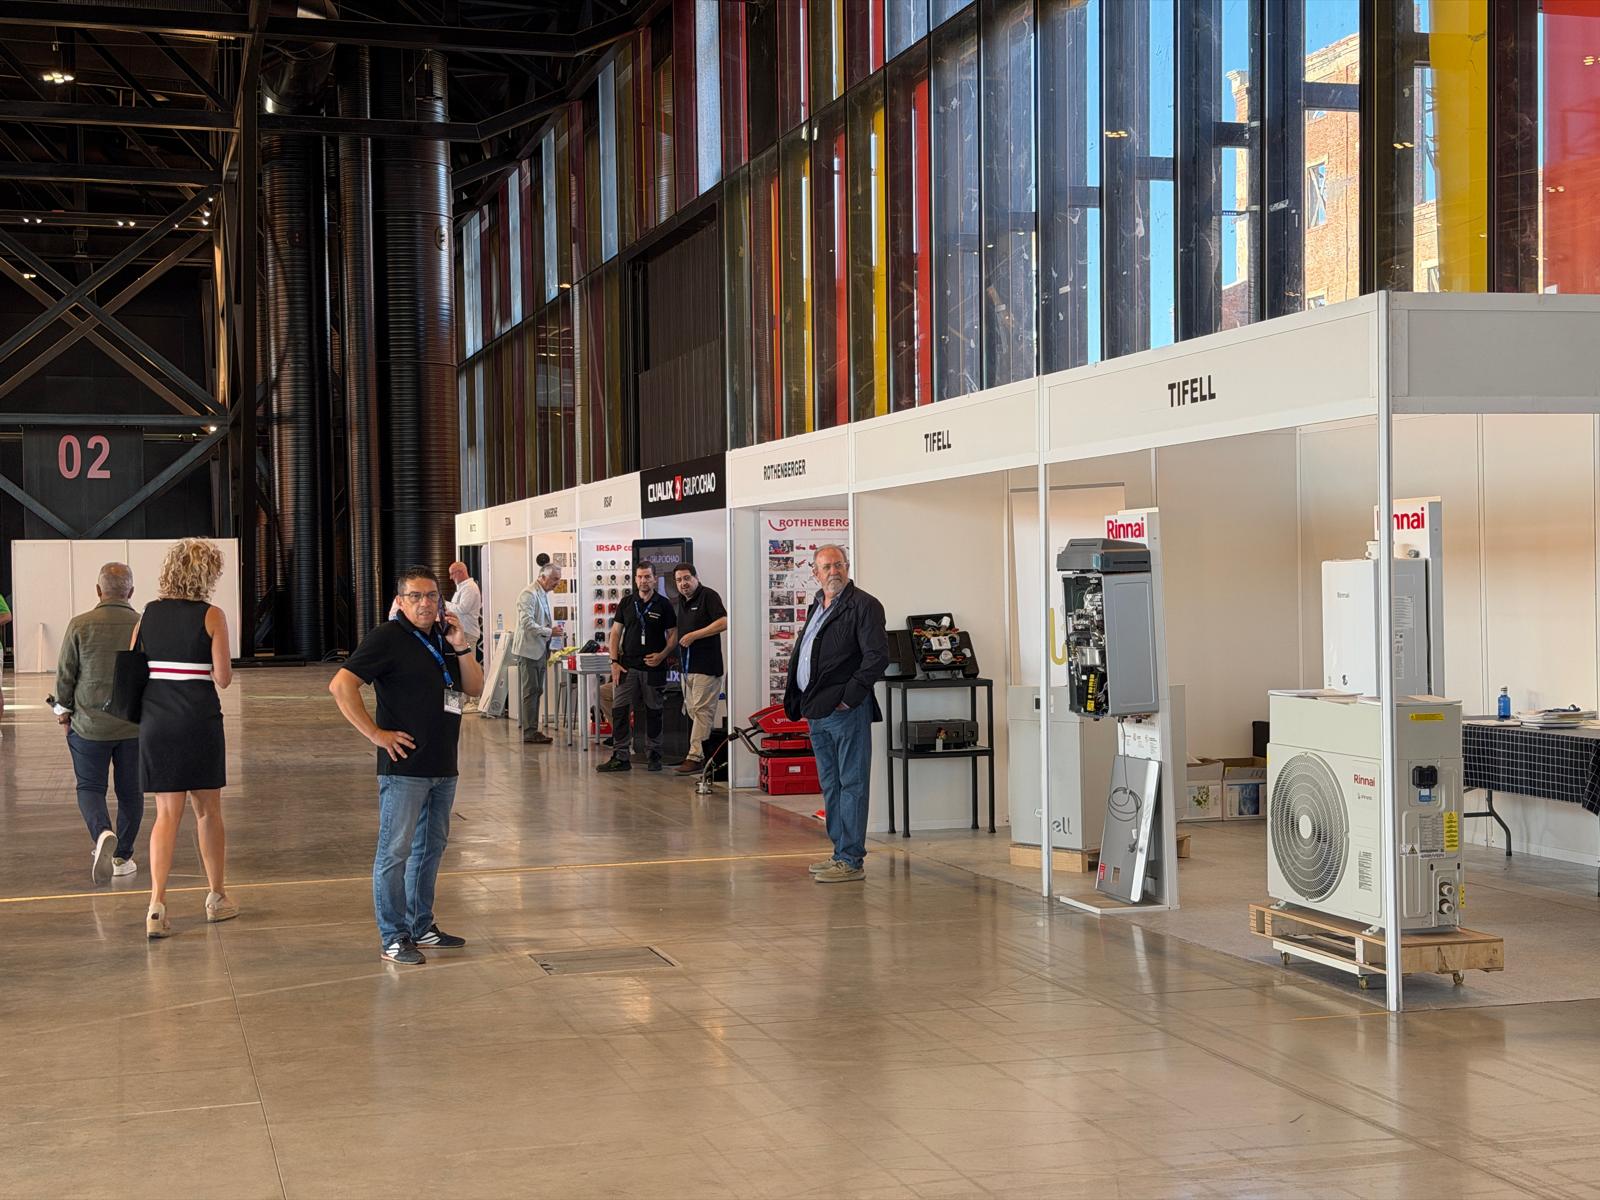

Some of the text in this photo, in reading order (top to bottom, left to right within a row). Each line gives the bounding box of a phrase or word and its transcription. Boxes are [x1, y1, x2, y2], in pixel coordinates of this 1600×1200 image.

[1167, 375, 1217, 408] TIFELL
[924, 430, 952, 453] TIFELL
[57, 434, 111, 480] 02
[763, 459, 807, 481] ROTHENBERGER
[647, 472, 716, 503] CUALIX GRUPOCHAO
[779, 518, 850, 528] ROTHENBERG
[1106, 517, 1145, 540] Rinnai
[1376, 506, 1425, 531] nnai
[595, 544, 622, 552] IRSAP
[666, 670, 681, 682] LIX
[1353, 774, 1376, 787] Rinnai
[1052, 816, 1073, 835] ell
